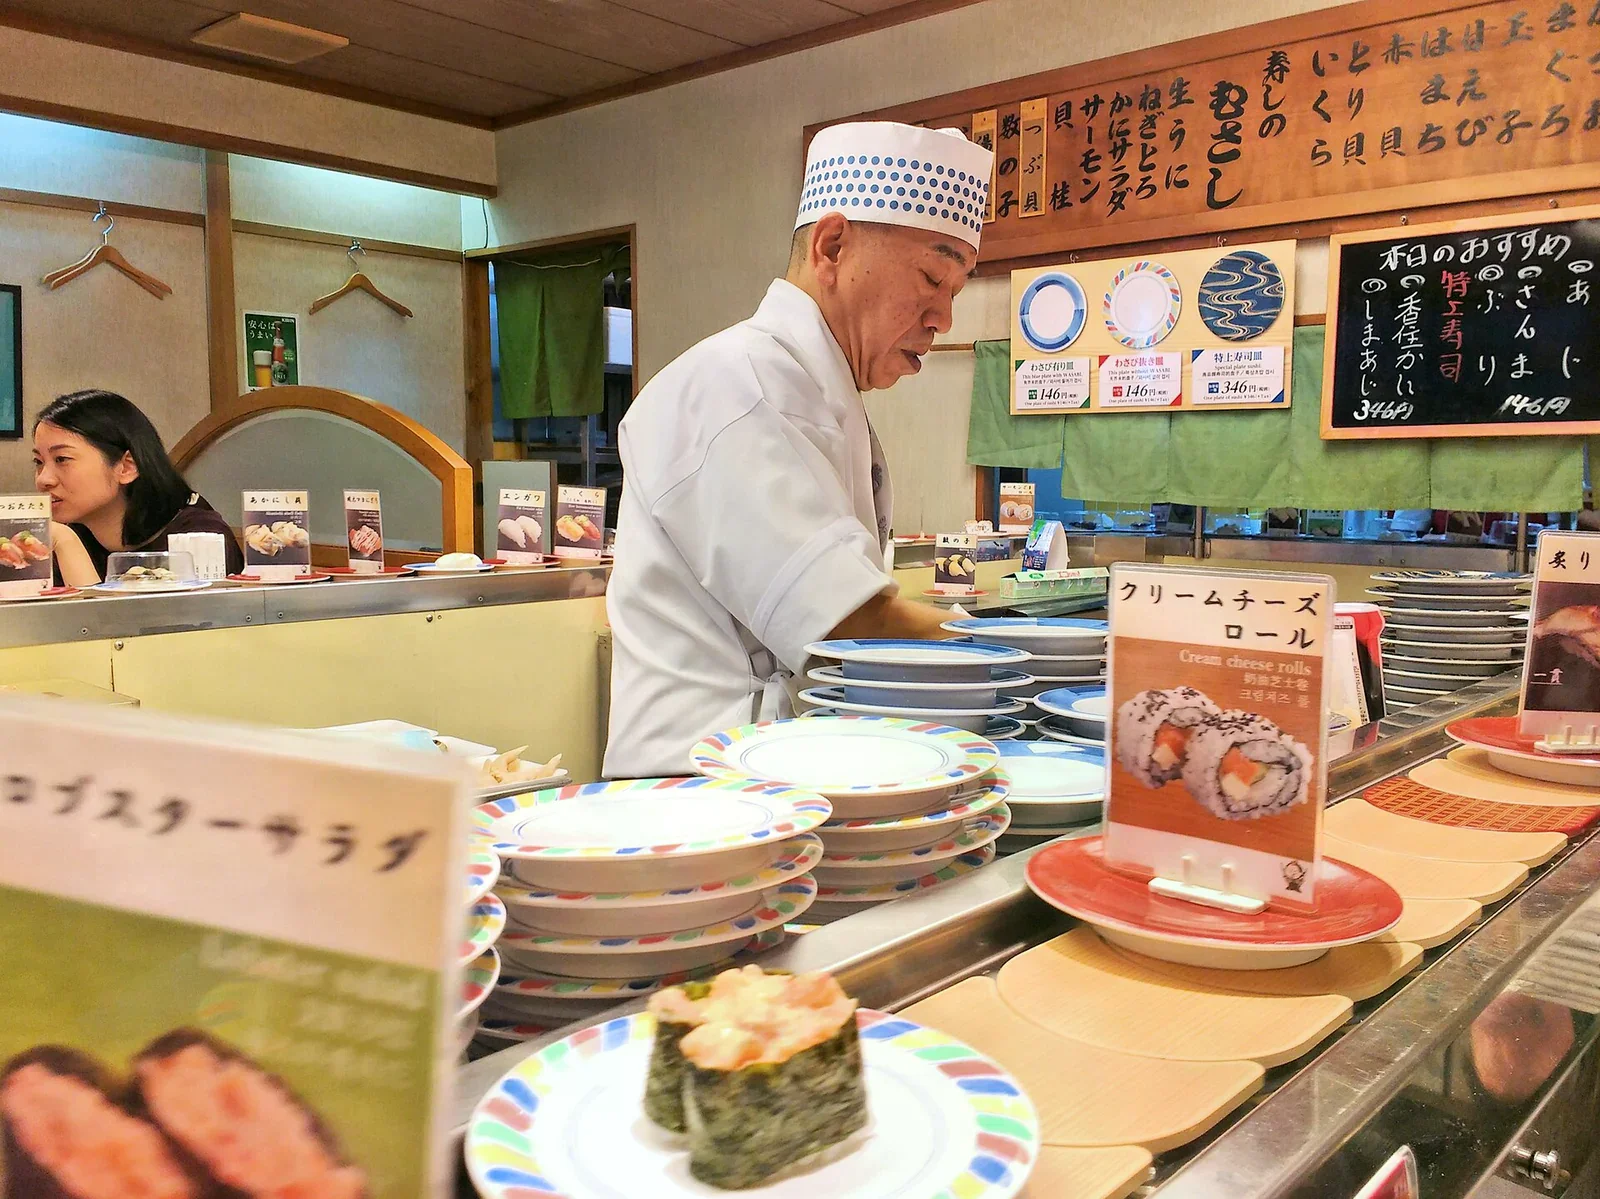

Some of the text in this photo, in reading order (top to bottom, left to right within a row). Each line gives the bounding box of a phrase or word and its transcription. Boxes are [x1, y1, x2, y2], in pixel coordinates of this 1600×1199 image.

[1258, 50, 1291, 138] 寿しの
[1311, 50, 1339, 166] いくら
[1343, 40, 1371, 166] とり貝
[1381, 33, 1416, 159] 赤貝
[1417, 26, 1454, 155] はまち
[1495, 11, 1534, 144] 玉子
[1540, 2, 1579, 138] まぐろ
[998, 113, 1020, 218] 数の子
[1023, 124, 1043, 212] つぶ貝
[1079, 93, 1104, 203] サーモン
[1106, 91, 1133, 218] かにサラダ
[1135, 84, 1164, 200] ねぎとろ
[1165, 76, 1195, 190] 生うに
[1207, 80, 1248, 210] むさし
[1379, 228, 1572, 271] 本日のおすすめ
[249, 330, 273, 339] うまい
[1213, 351, 1263, 363] 特上寿司皿
[1359, 299, 1381, 396] しまあじ
[1477, 289, 1504, 386] ぶり
[1510, 284, 1536, 378] さんま
[1562, 279, 1591, 379] あじ
[503, 493, 541, 501] エンガワ
[1120, 581, 1321, 616] クリームチーズ
[1548, 550, 1591, 570] 炙り
[1179, 649, 1312, 676] Cream cheese rolls
[1225, 624, 1315, 649] ロール
